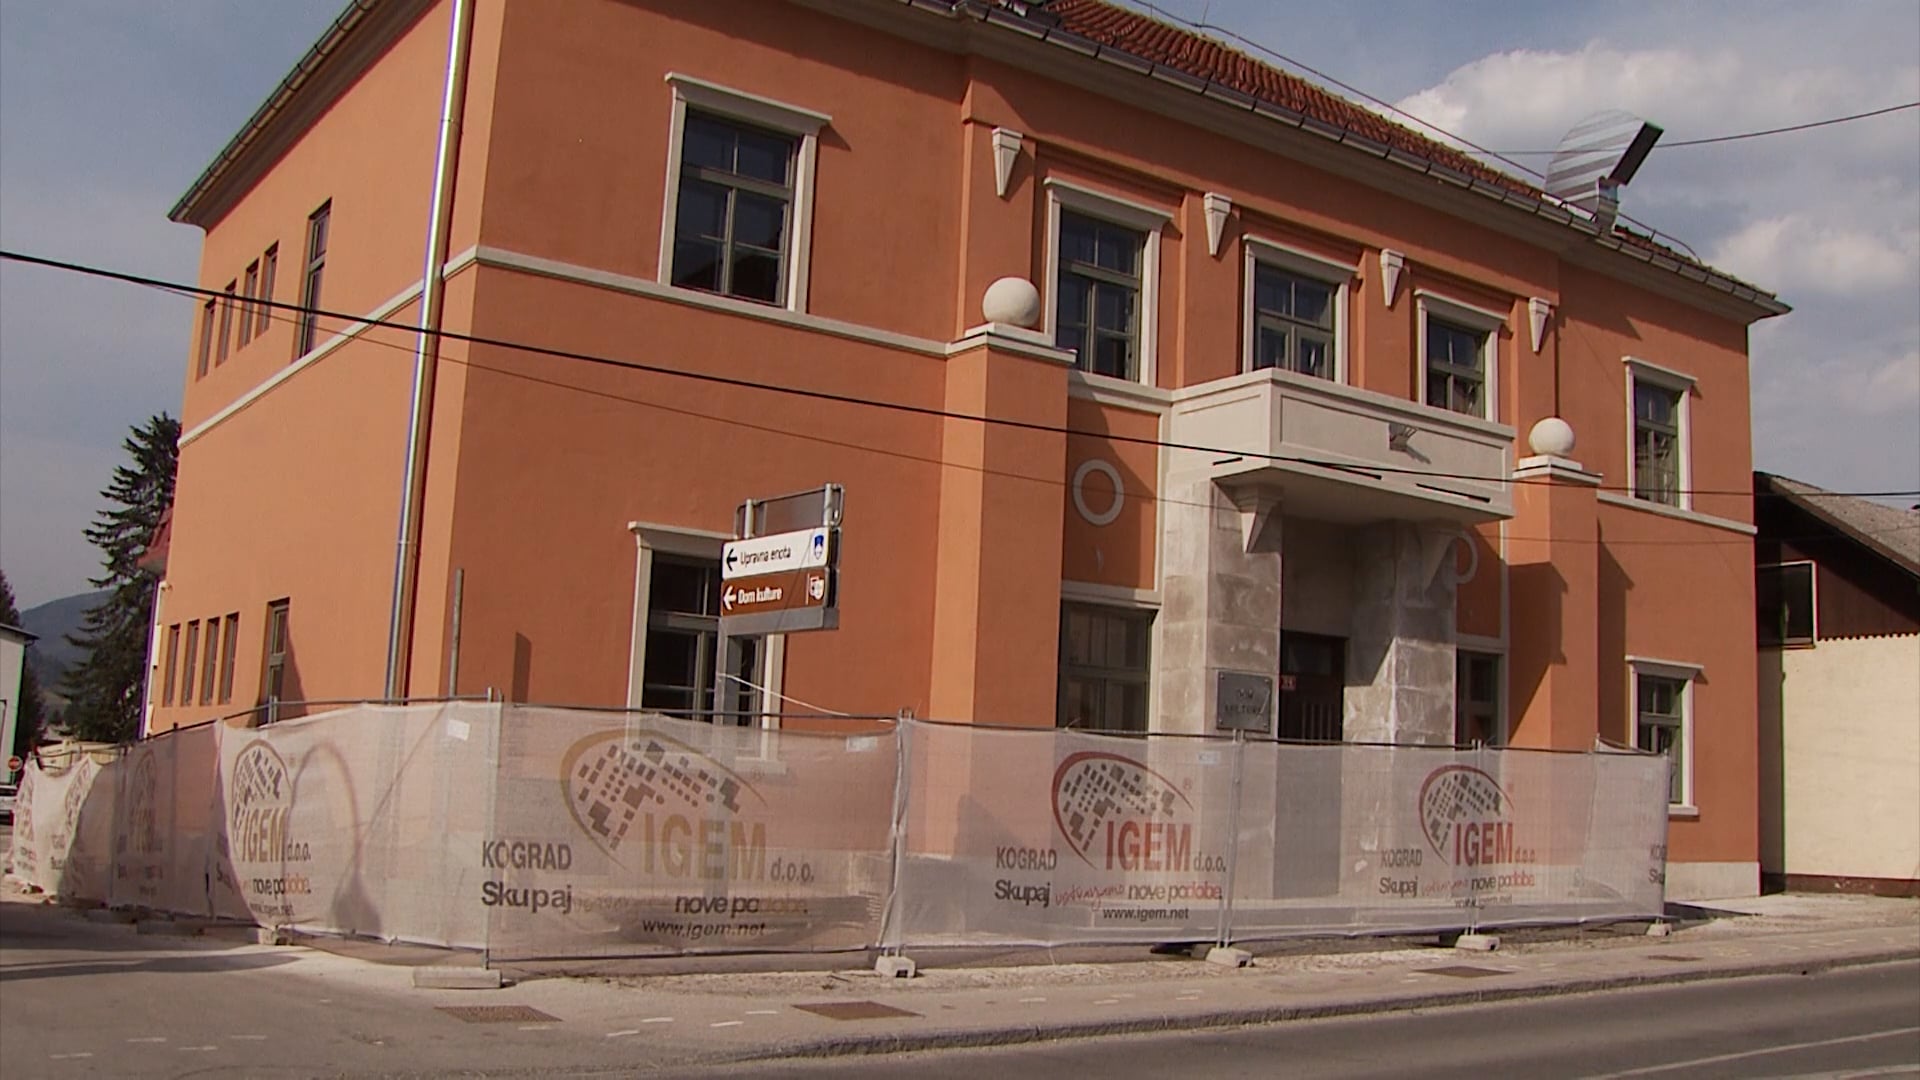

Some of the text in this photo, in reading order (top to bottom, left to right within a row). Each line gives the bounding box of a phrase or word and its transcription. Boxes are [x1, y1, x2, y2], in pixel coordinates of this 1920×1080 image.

[740, 546, 791, 569] Upravna enota
[738, 586, 782, 604] Dom kulture
[242, 807, 288, 862] IGEM
[1105, 820, 1226, 872] IGEM d.o.o.
[1455, 822, 1513, 866] IGEM
[482, 841, 572, 871] KOGRAD
[643, 813, 815, 883] IGEM d.o.o.
[996, 847, 1057, 871] KOGRAD
[1380, 849, 1423, 868] KOGRAD
[481, 881, 573, 912] Skupaj
[674, 895, 728, 914] nove
[994, 879, 1050, 908] Skupaj
[1128, 883, 1166, 900] nove
[1379, 876, 1419, 898] Skupaj
[1471, 876, 1497, 891] nove
[1103, 906, 1189, 922] www.igem.net
[642, 919, 766, 940] www.igem.net
